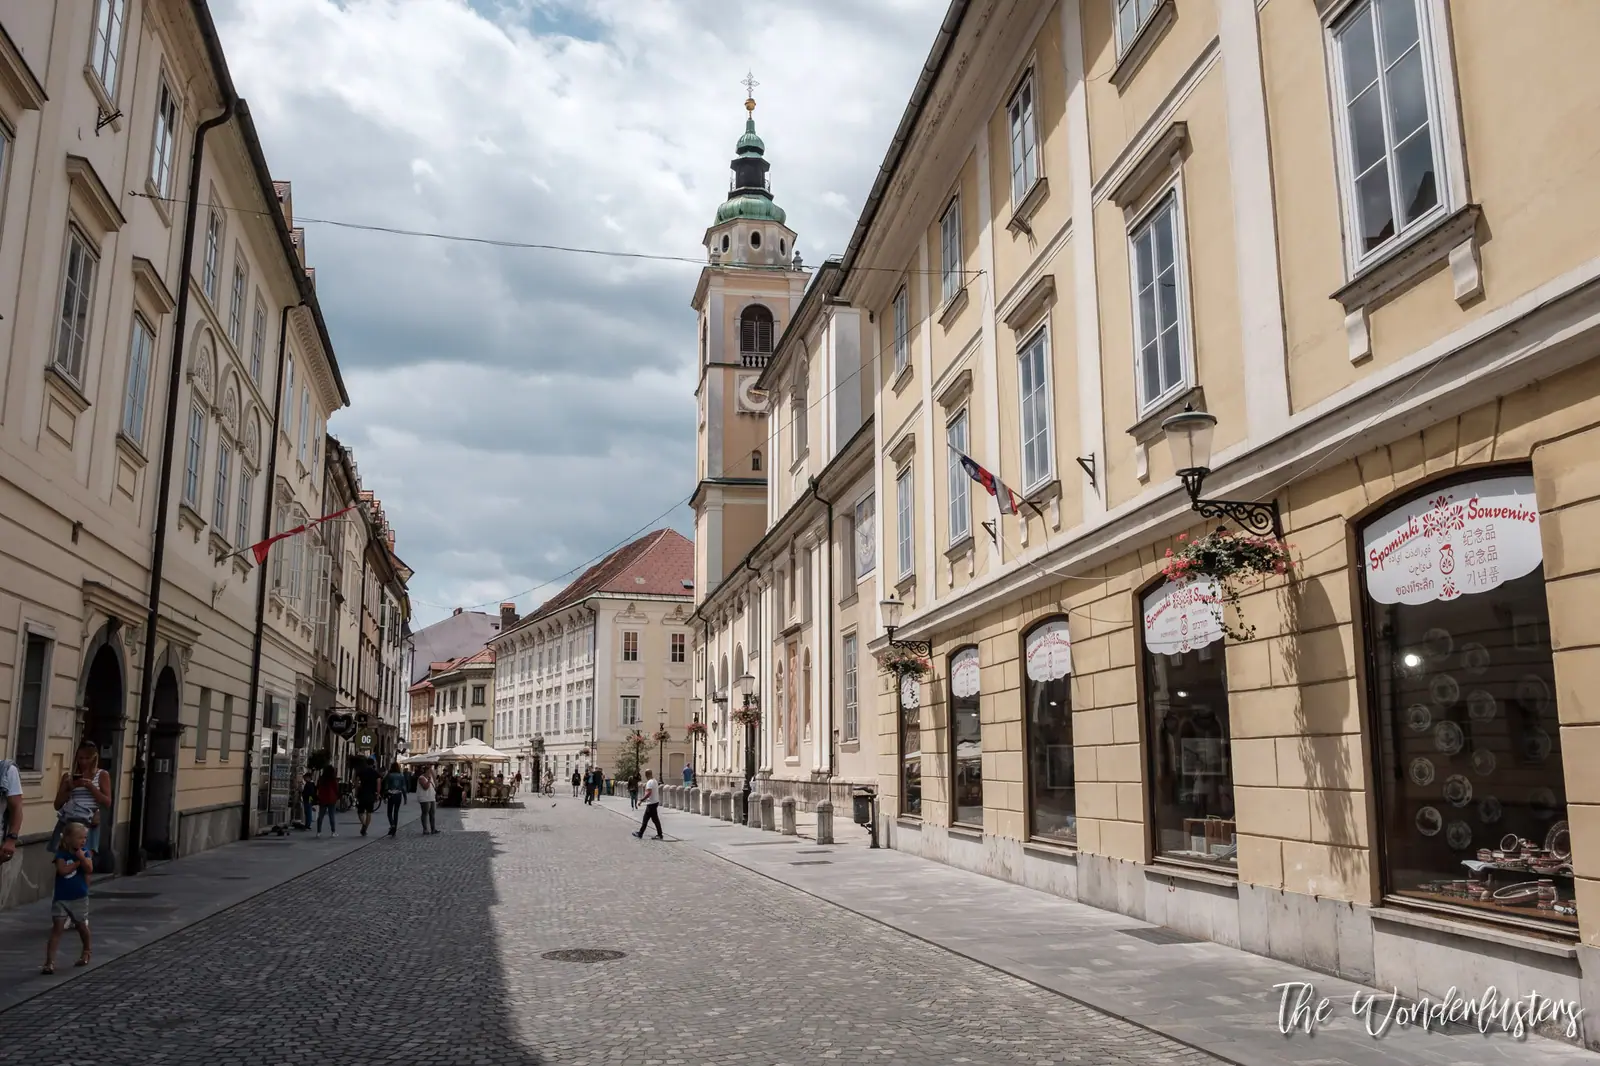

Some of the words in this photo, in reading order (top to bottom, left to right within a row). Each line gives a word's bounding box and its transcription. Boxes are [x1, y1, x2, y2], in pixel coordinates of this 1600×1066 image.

[1369, 515, 1419, 571] Spominki
[1467, 497, 1536, 523] Souvenirs
[1462, 523, 1496, 546] 纪念品
[1466, 565, 1499, 586] 기념품
[361, 735, 372, 744] OG
